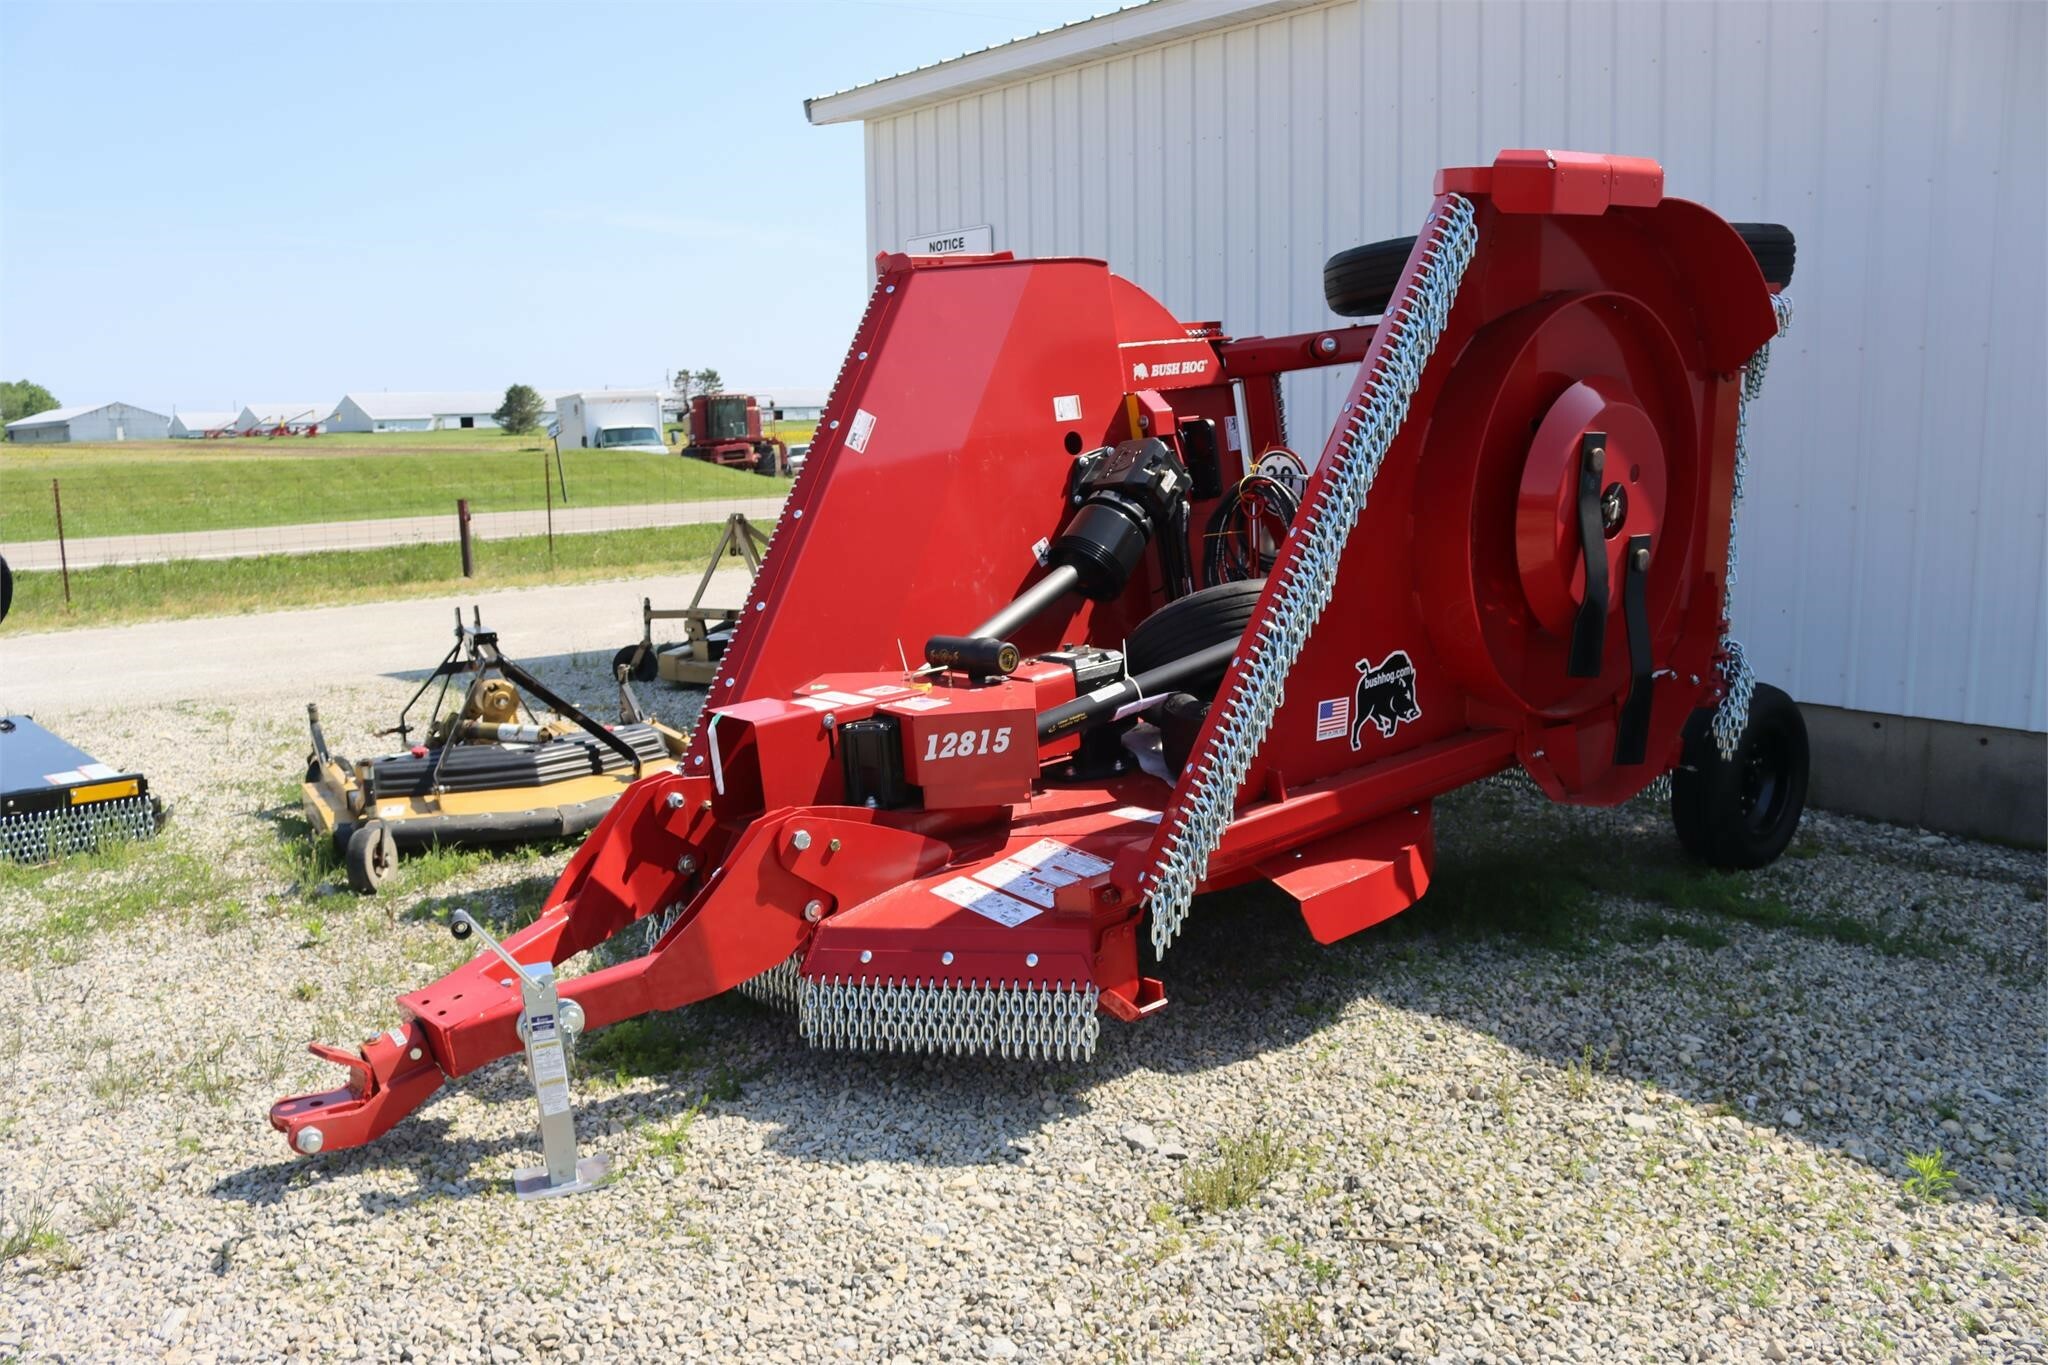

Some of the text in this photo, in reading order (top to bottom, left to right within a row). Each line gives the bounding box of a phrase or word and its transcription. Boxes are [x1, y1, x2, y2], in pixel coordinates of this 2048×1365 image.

[929, 236, 965, 253] NOTICE
[1151, 361, 1181, 377] BUSH
[1364, 666, 1411, 689] bushhog.com
[923, 726, 1012, 761] 12815
